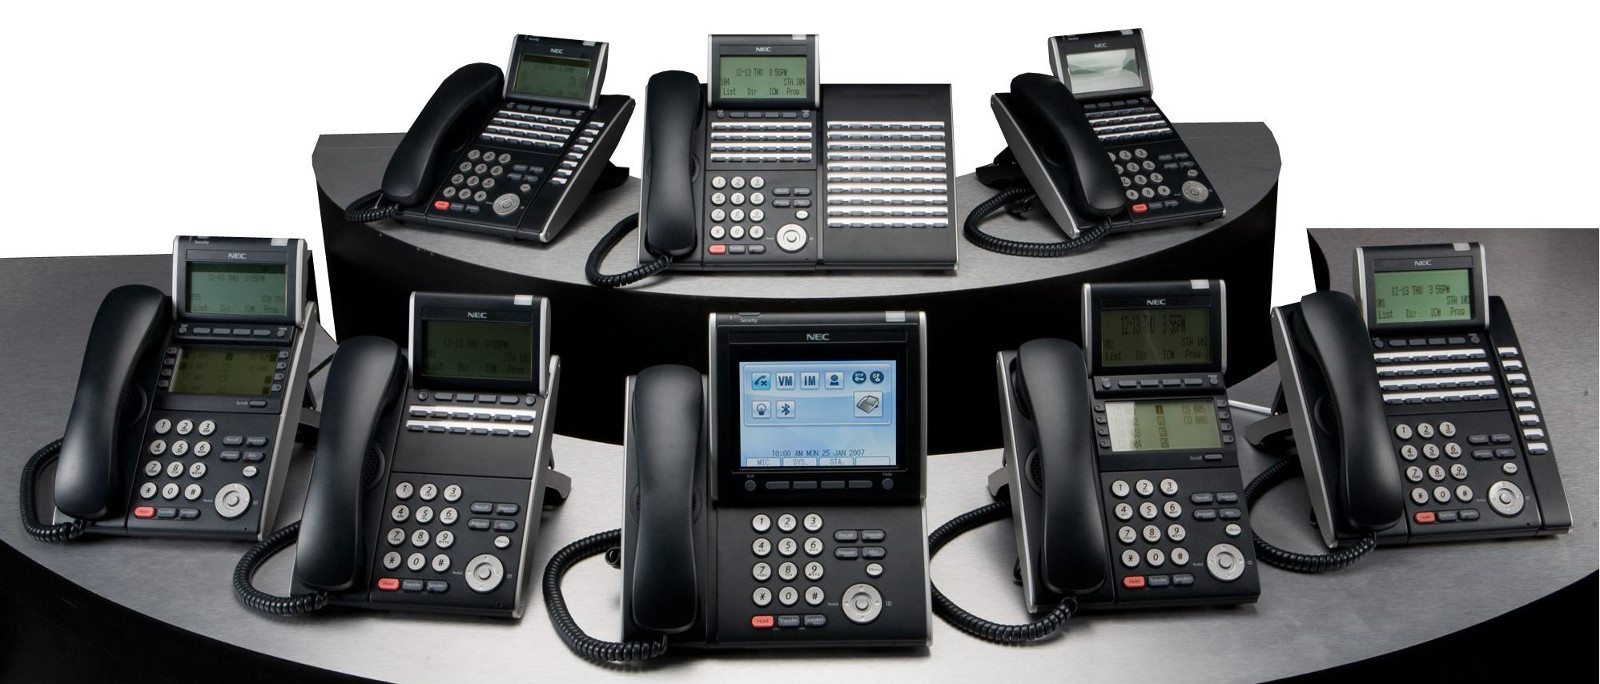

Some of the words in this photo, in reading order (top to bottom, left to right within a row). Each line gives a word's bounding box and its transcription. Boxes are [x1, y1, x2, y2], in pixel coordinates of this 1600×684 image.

[736, 68, 751, 76] 12-13
[754, 68, 763, 76] THU
[1392, 286, 1409, 296] 12-13
[1412, 286, 1423, 294] THU
[1378, 310, 1393, 319] List
[778, 376, 792, 386] VM
[804, 376, 816, 386] IM
[784, 517, 791, 525] 2
[810, 516, 816, 525] 3
[758, 541, 764, 549] 4
[785, 541, 791, 550] 5
[810, 541, 817, 549] 6
[413, 557, 420, 566] 0
[1152, 553, 1159, 561] 0
[759, 566, 766, 574] 7
[785, 565, 791, 574] 8
[811, 565, 818, 574] 9
[785, 592, 792, 600] 0
